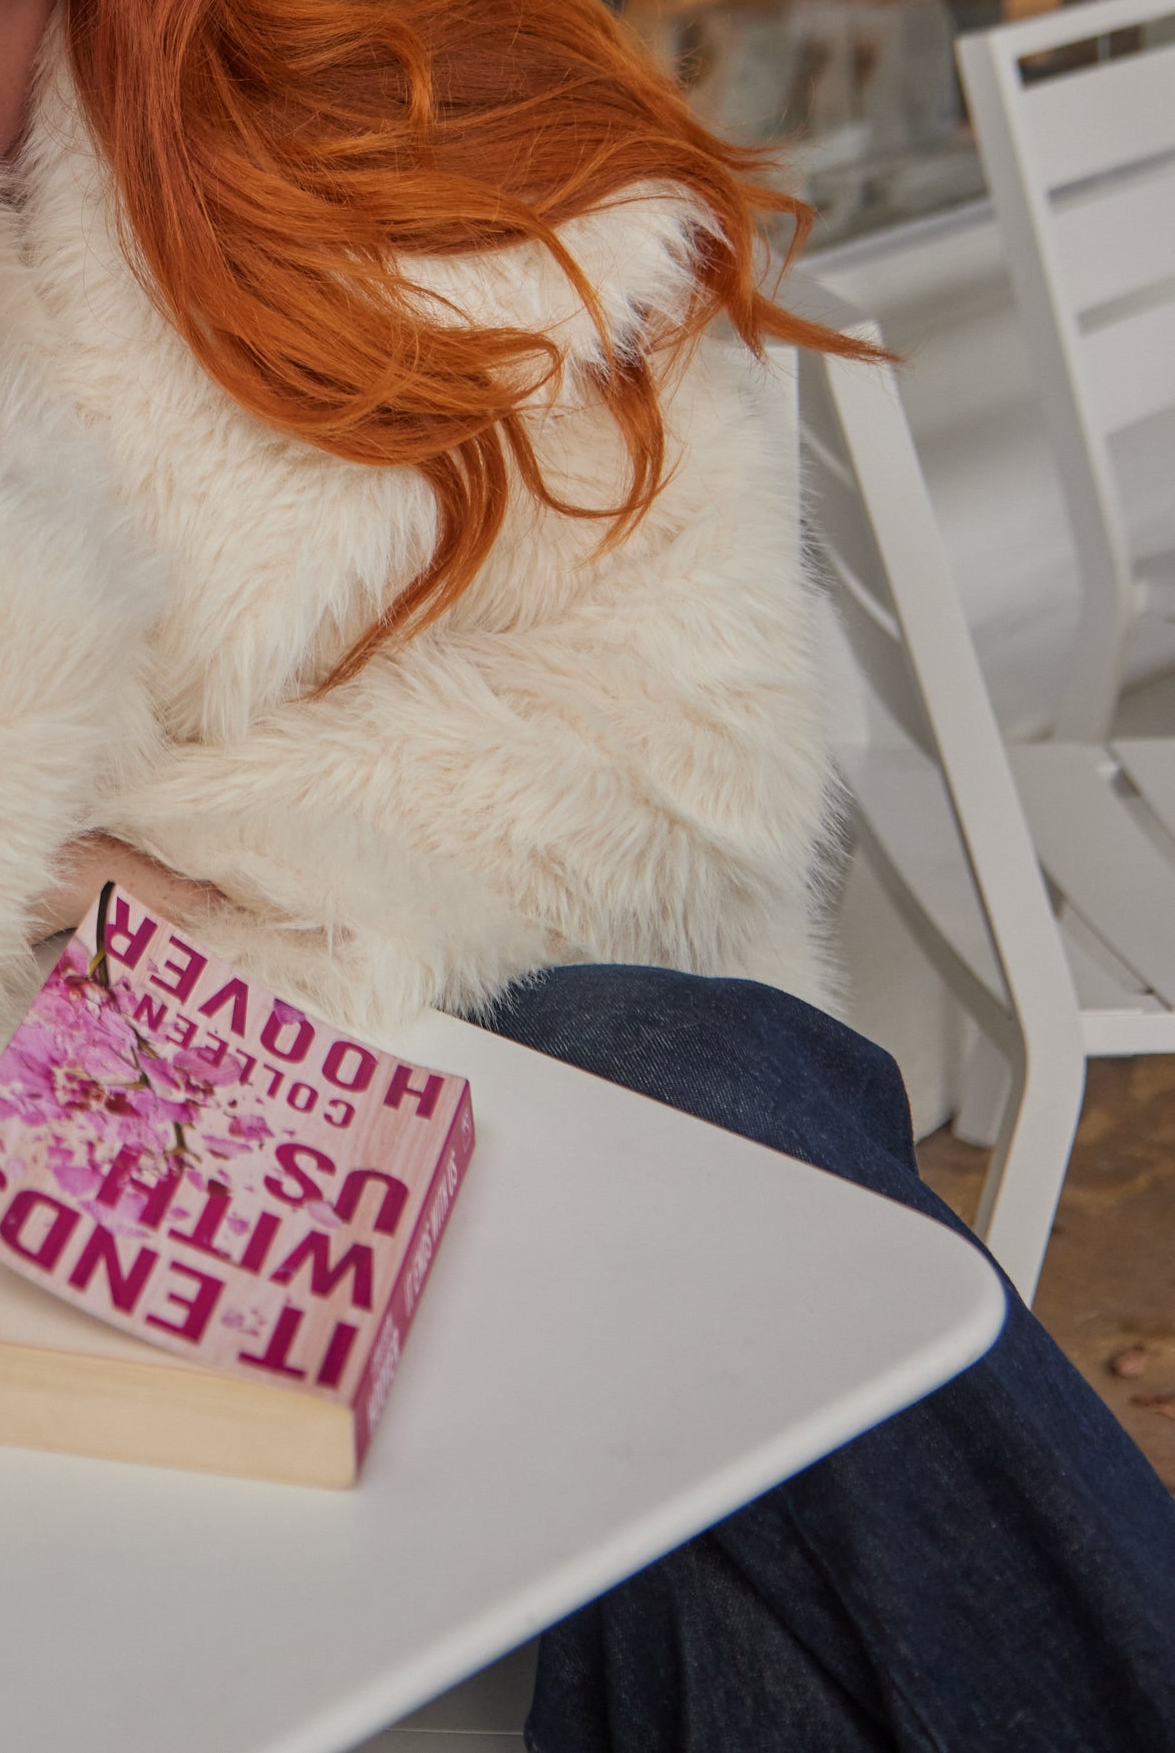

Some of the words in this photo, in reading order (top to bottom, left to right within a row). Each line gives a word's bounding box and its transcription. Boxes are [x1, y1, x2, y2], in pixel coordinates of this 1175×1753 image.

[101, 896, 446, 1120] HOOVER
[131, 993, 356, 1130] COLLEEN
[93, 1142, 375, 1312] WITH
[262, 1142, 410, 1237] US
[238, 1305, 358, 1390] IT
